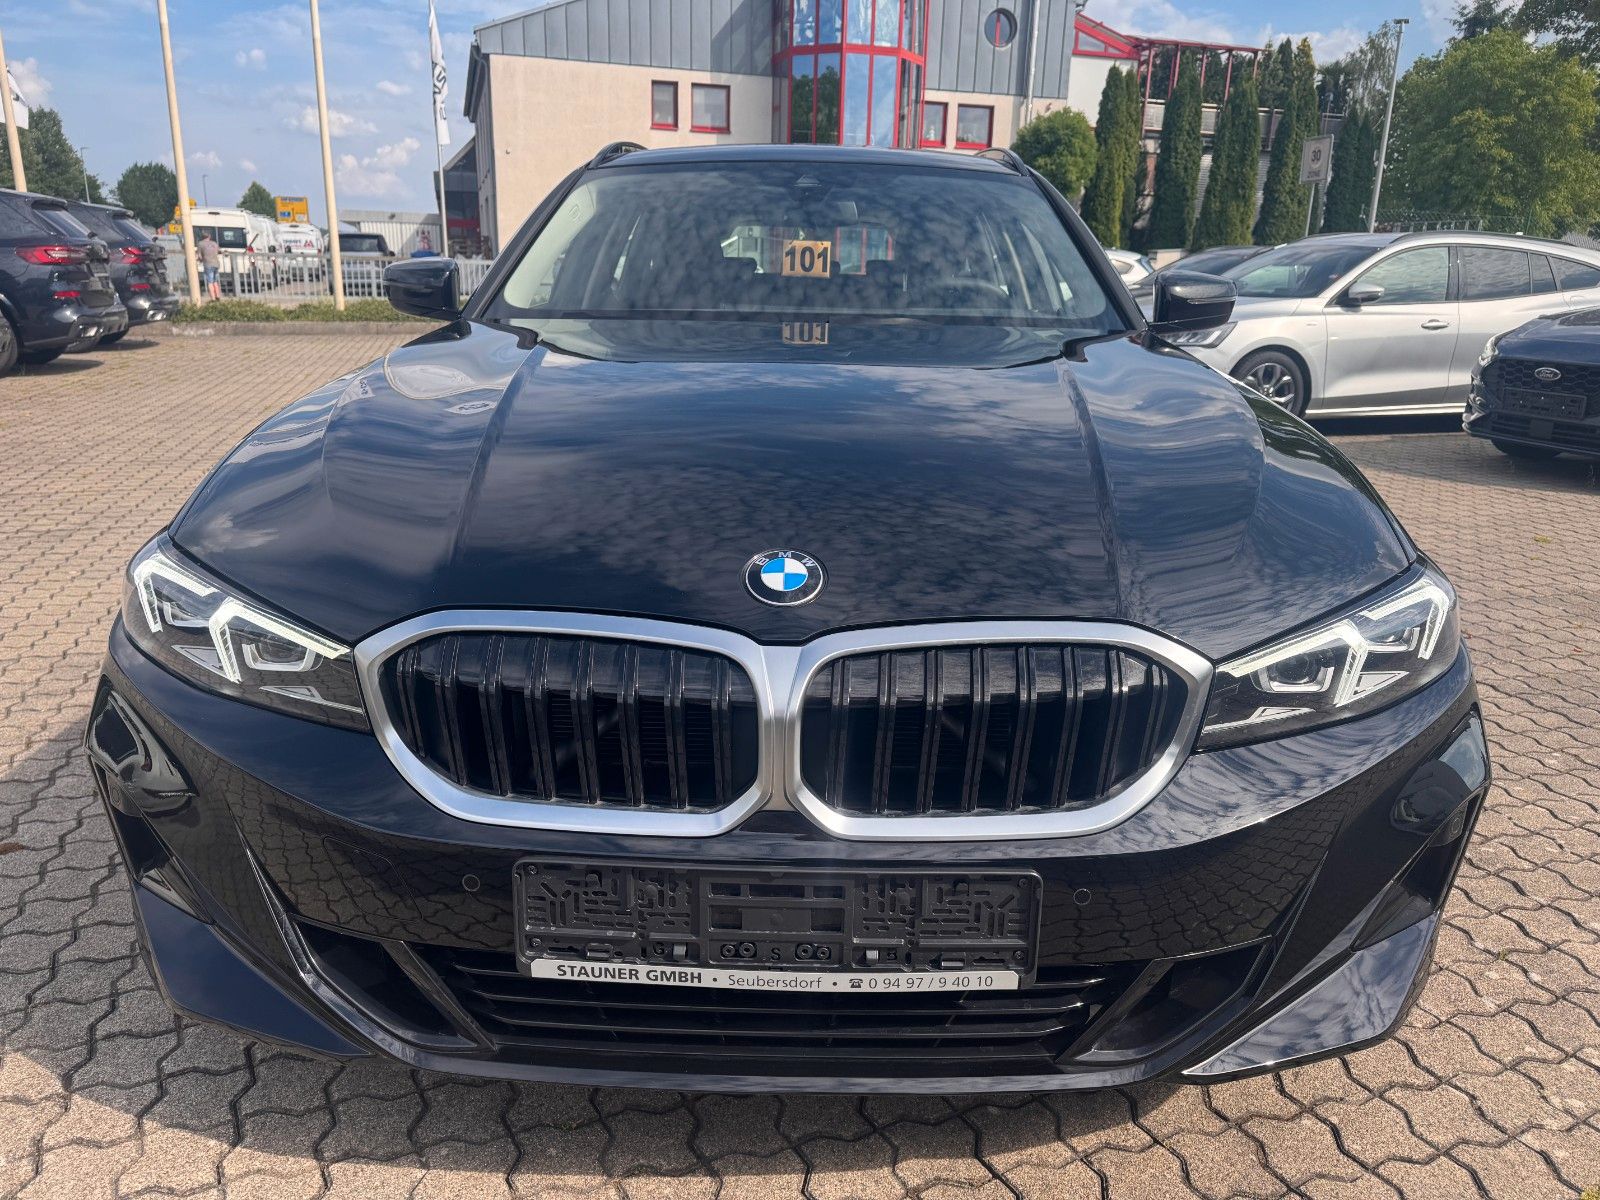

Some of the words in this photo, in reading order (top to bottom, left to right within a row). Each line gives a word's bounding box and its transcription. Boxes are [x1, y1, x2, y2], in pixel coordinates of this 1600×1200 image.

[1311, 149, 1322, 162] 30
[785, 245, 830, 272] 101
[755, 551, 816, 567] BMW
[556, 964, 640, 981] STAUNER
[645, 969, 702, 984] GMBH
[728, 974, 822, 989] Seubersdorf
[868, 977, 878, 989] 0
[883, 977, 901, 989] 94
[906, 977, 924, 989] 97
[938, 976, 947, 988] 9
[951, 976, 970, 988] 40
[977, 975, 993, 987] 10
